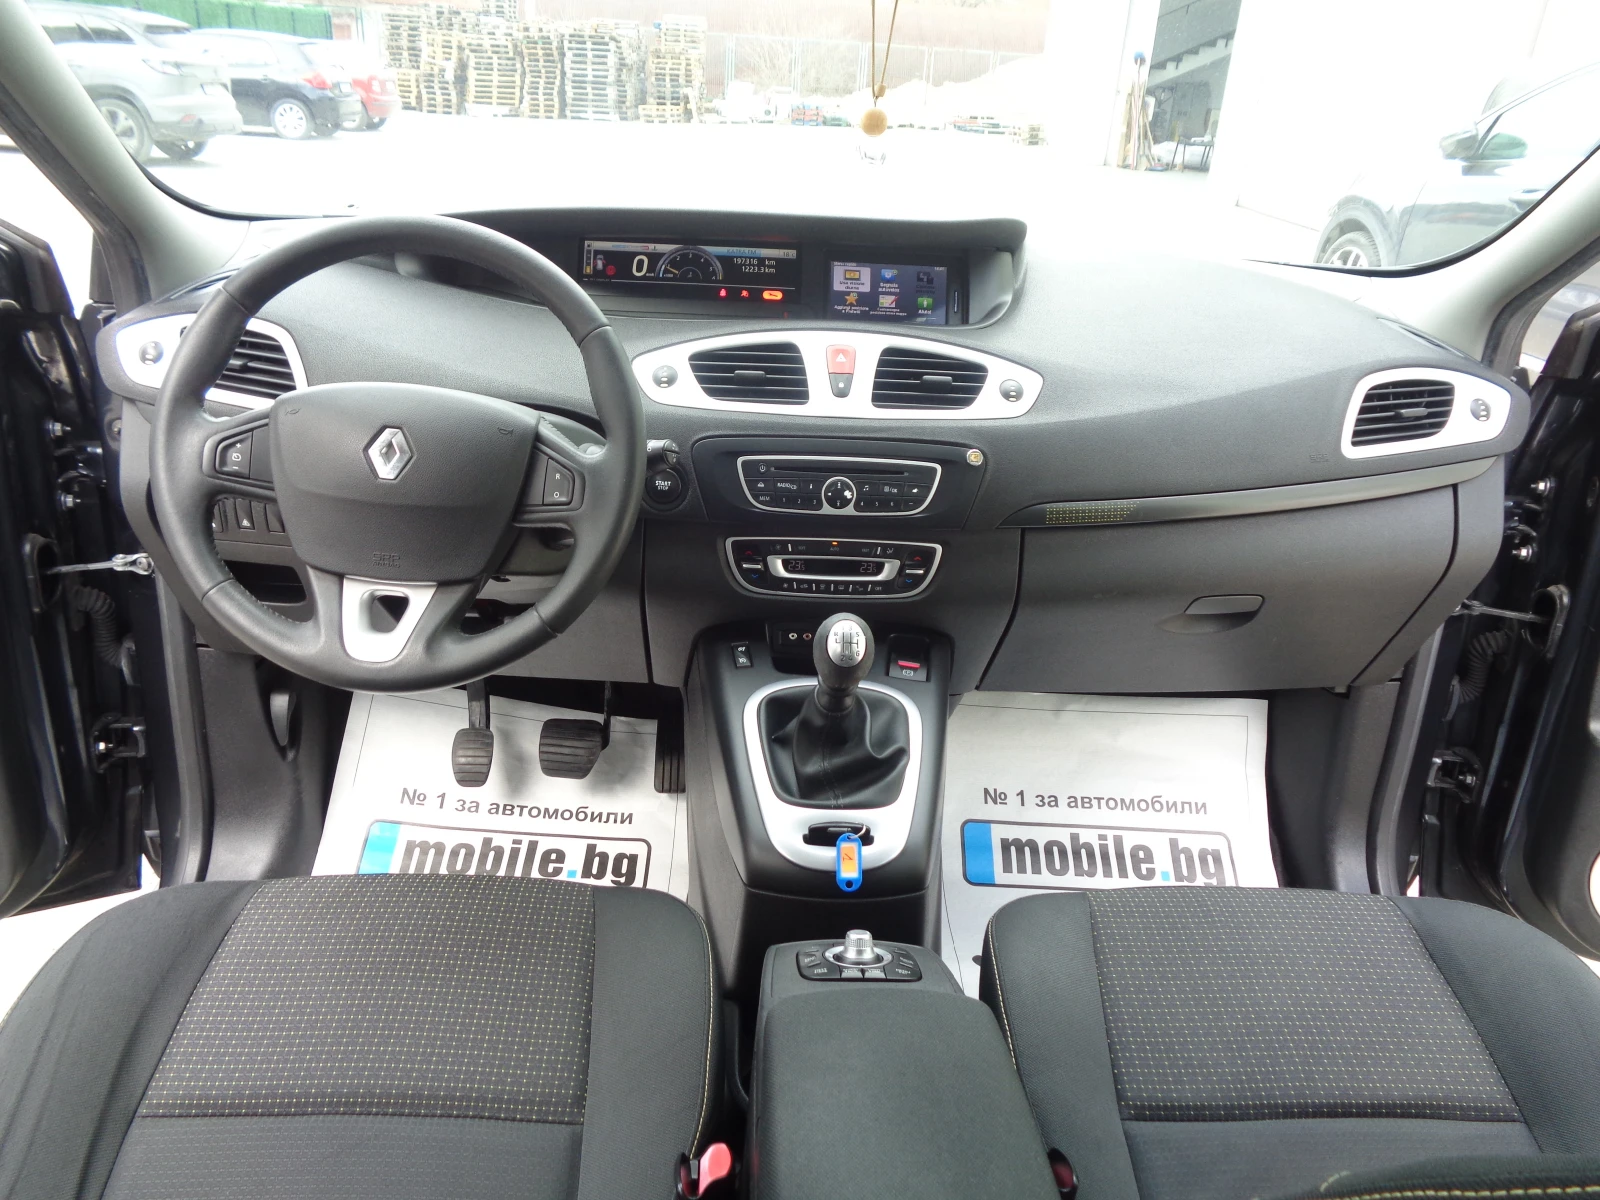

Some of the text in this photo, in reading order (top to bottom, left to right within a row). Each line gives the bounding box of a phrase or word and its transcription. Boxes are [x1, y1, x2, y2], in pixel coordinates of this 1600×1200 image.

[632, 255, 648, 276] 0
[400, 787, 633, 825] № 1 за автомобили
[983, 787, 1207, 815] № 1 за автомобили
[400, 837, 639, 887] mobile.bg
[1000, 833, 1226, 887] mobile.bg
